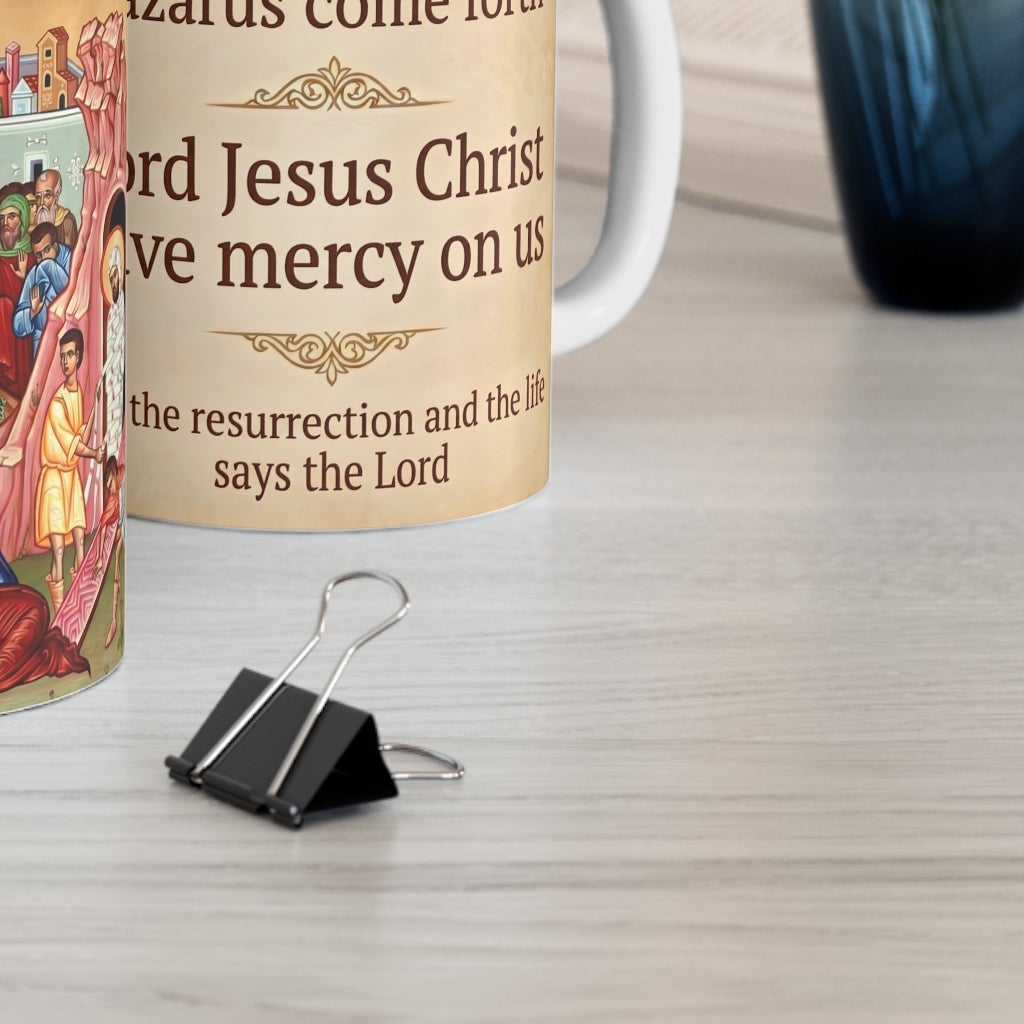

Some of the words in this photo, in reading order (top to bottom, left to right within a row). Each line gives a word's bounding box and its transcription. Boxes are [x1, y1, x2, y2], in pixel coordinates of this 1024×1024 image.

[221, 142, 393, 217] Jesus
[415, 125, 544, 201] Christ
[126, 232, 195, 284] ve
[216, 240, 425, 304] mercy
[440, 230, 503, 282] on
[513, 215, 545, 268] us
[129, 390, 180, 432] the
[190, 402, 415, 440] resurrection
[424, 389, 478, 433] and
[486, 384, 520, 423] the
[525, 368, 545, 411] life
[214, 457, 291, 502] says
[302, 450, 363, 492] the
[374, 442, 450, 489] Lord
